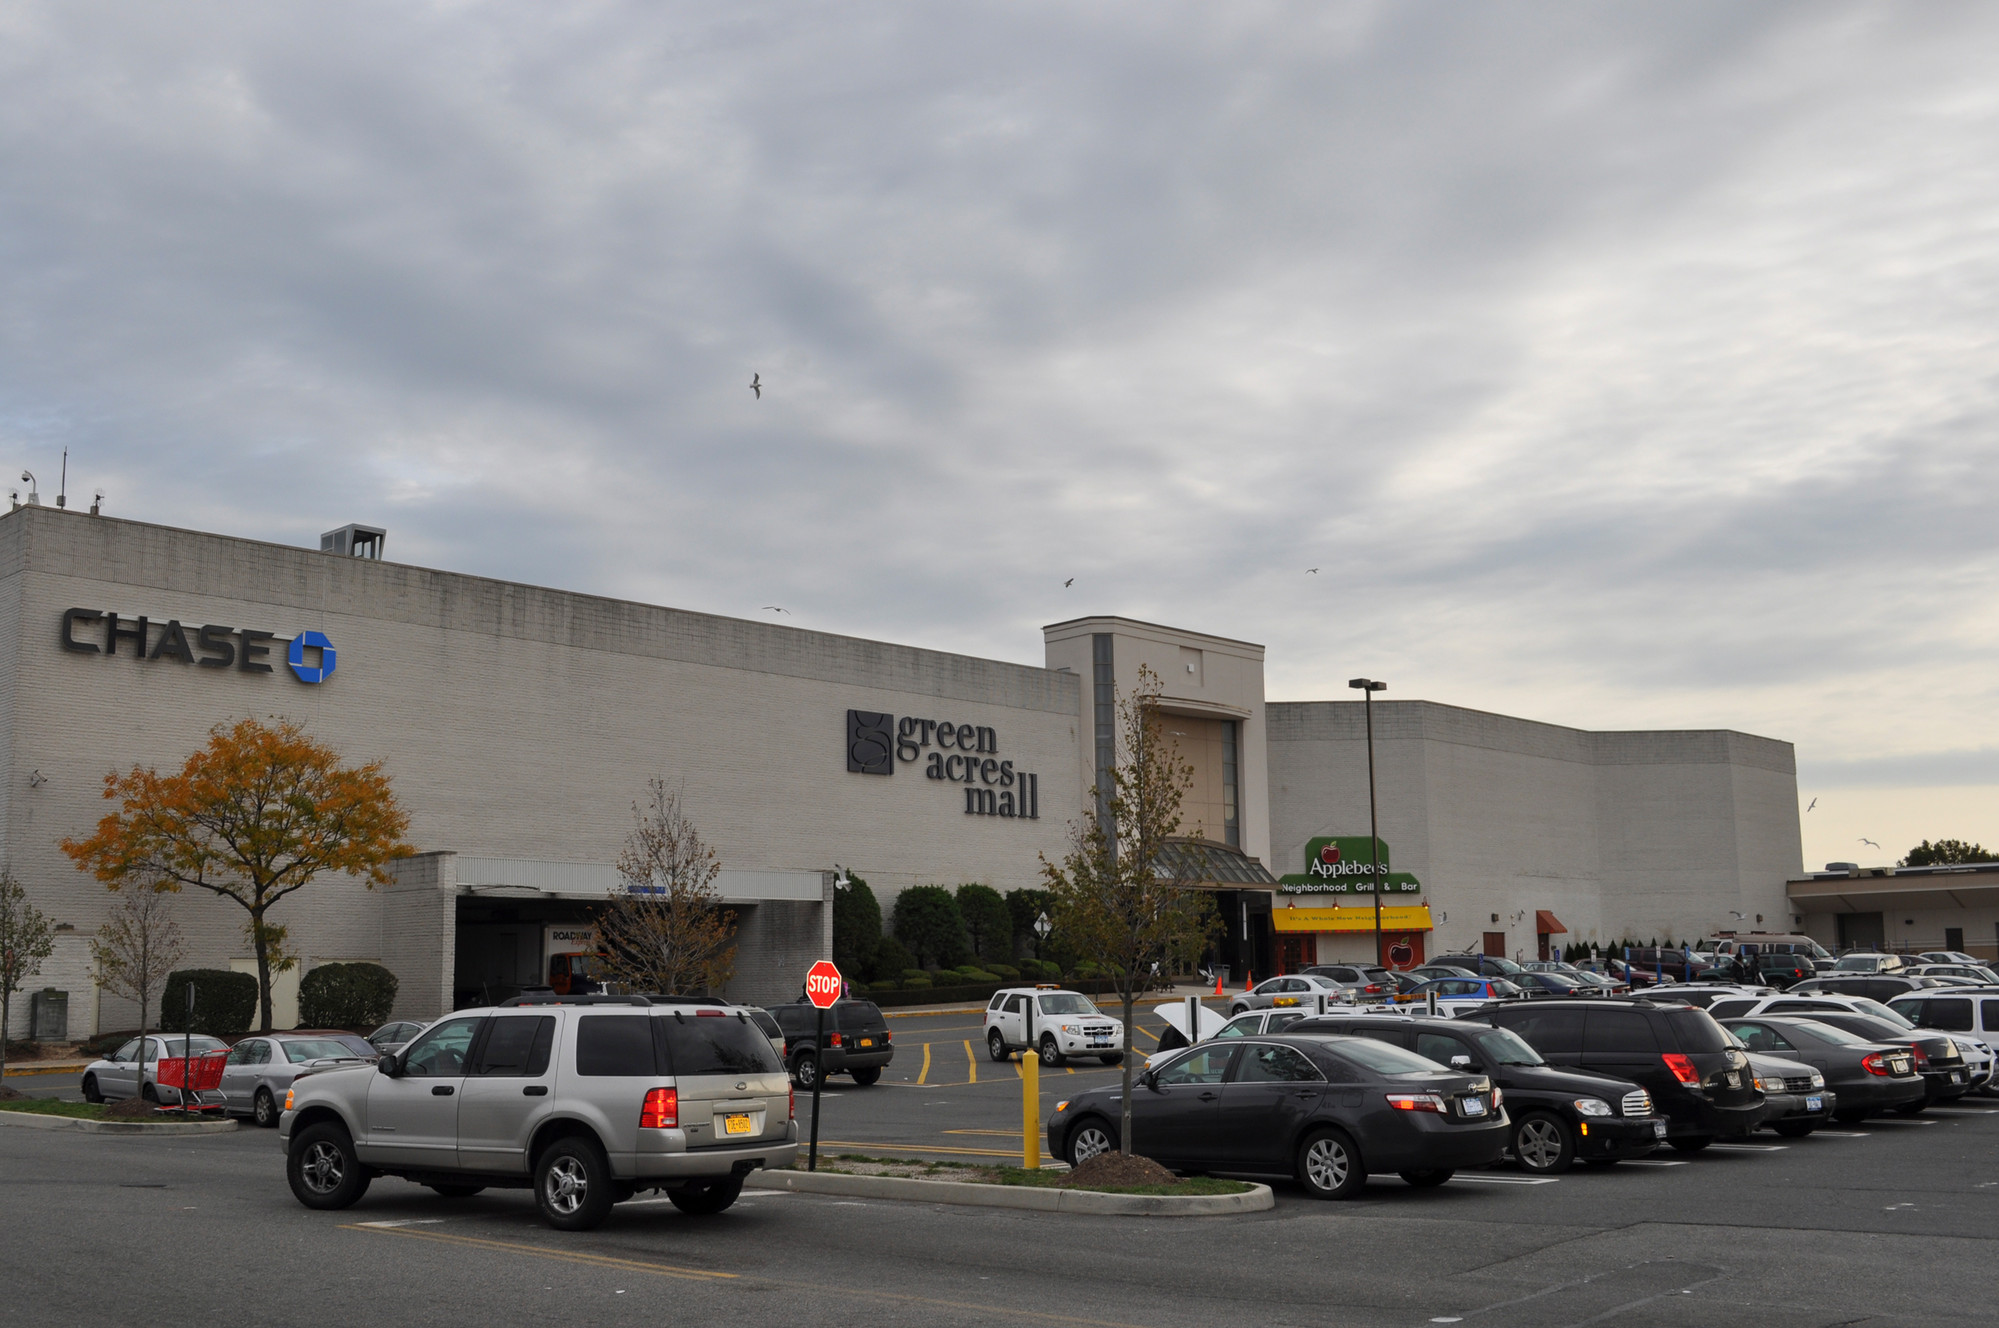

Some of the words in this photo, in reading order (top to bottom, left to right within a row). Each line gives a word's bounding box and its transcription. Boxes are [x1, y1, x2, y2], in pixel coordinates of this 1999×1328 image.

[62, 607, 275, 673] CHASE
[897, 716, 999, 762] green
[926, 752, 1015, 786] acres
[964, 772, 1040, 819] mall
[1282, 883, 1347, 894] Neighborhood
[1355, 882, 1375, 891] Grill
[1384, 882, 1390, 891] &
[1401, 882, 1417, 891] Bar
[809, 975, 839, 994] STOP
